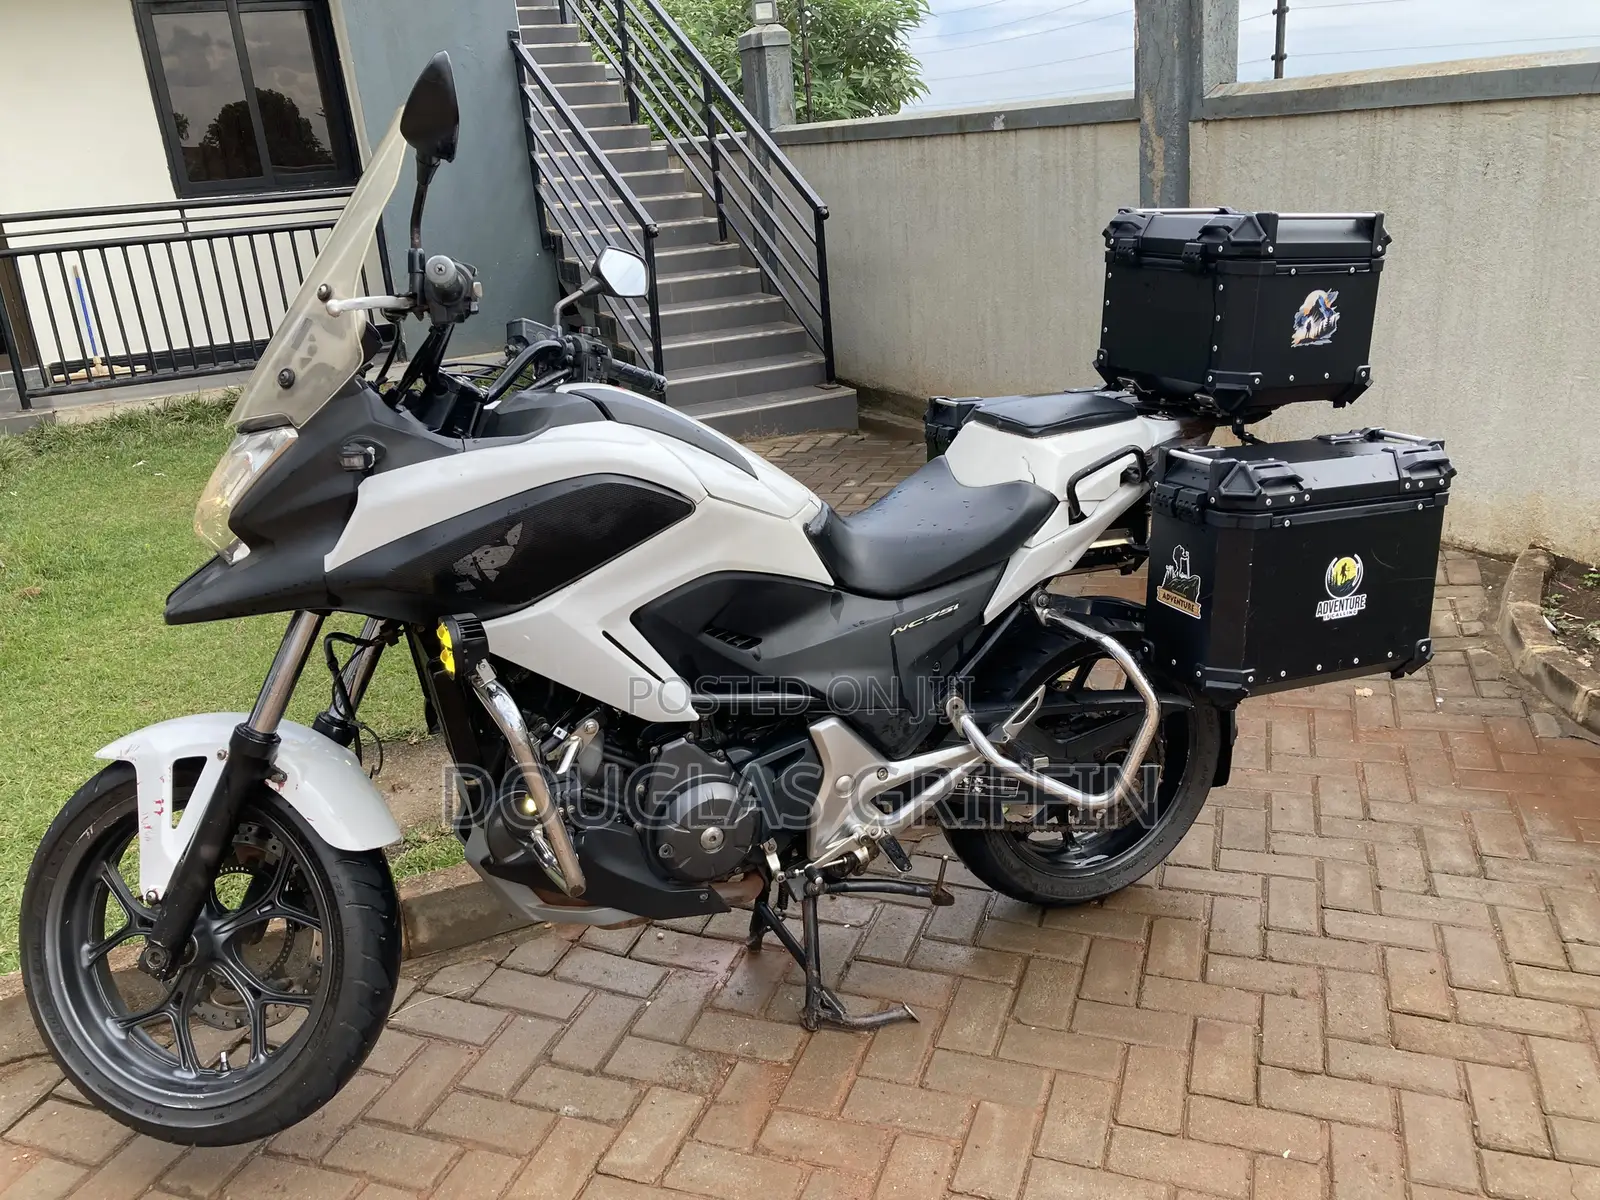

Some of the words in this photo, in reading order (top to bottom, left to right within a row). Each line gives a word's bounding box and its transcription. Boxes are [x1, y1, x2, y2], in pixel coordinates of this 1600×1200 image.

[1162, 592, 1195, 612] ADVENTURE
[1316, 595, 1366, 616] ADVENTURE
[1331, 609, 1357, 619] CALLING
